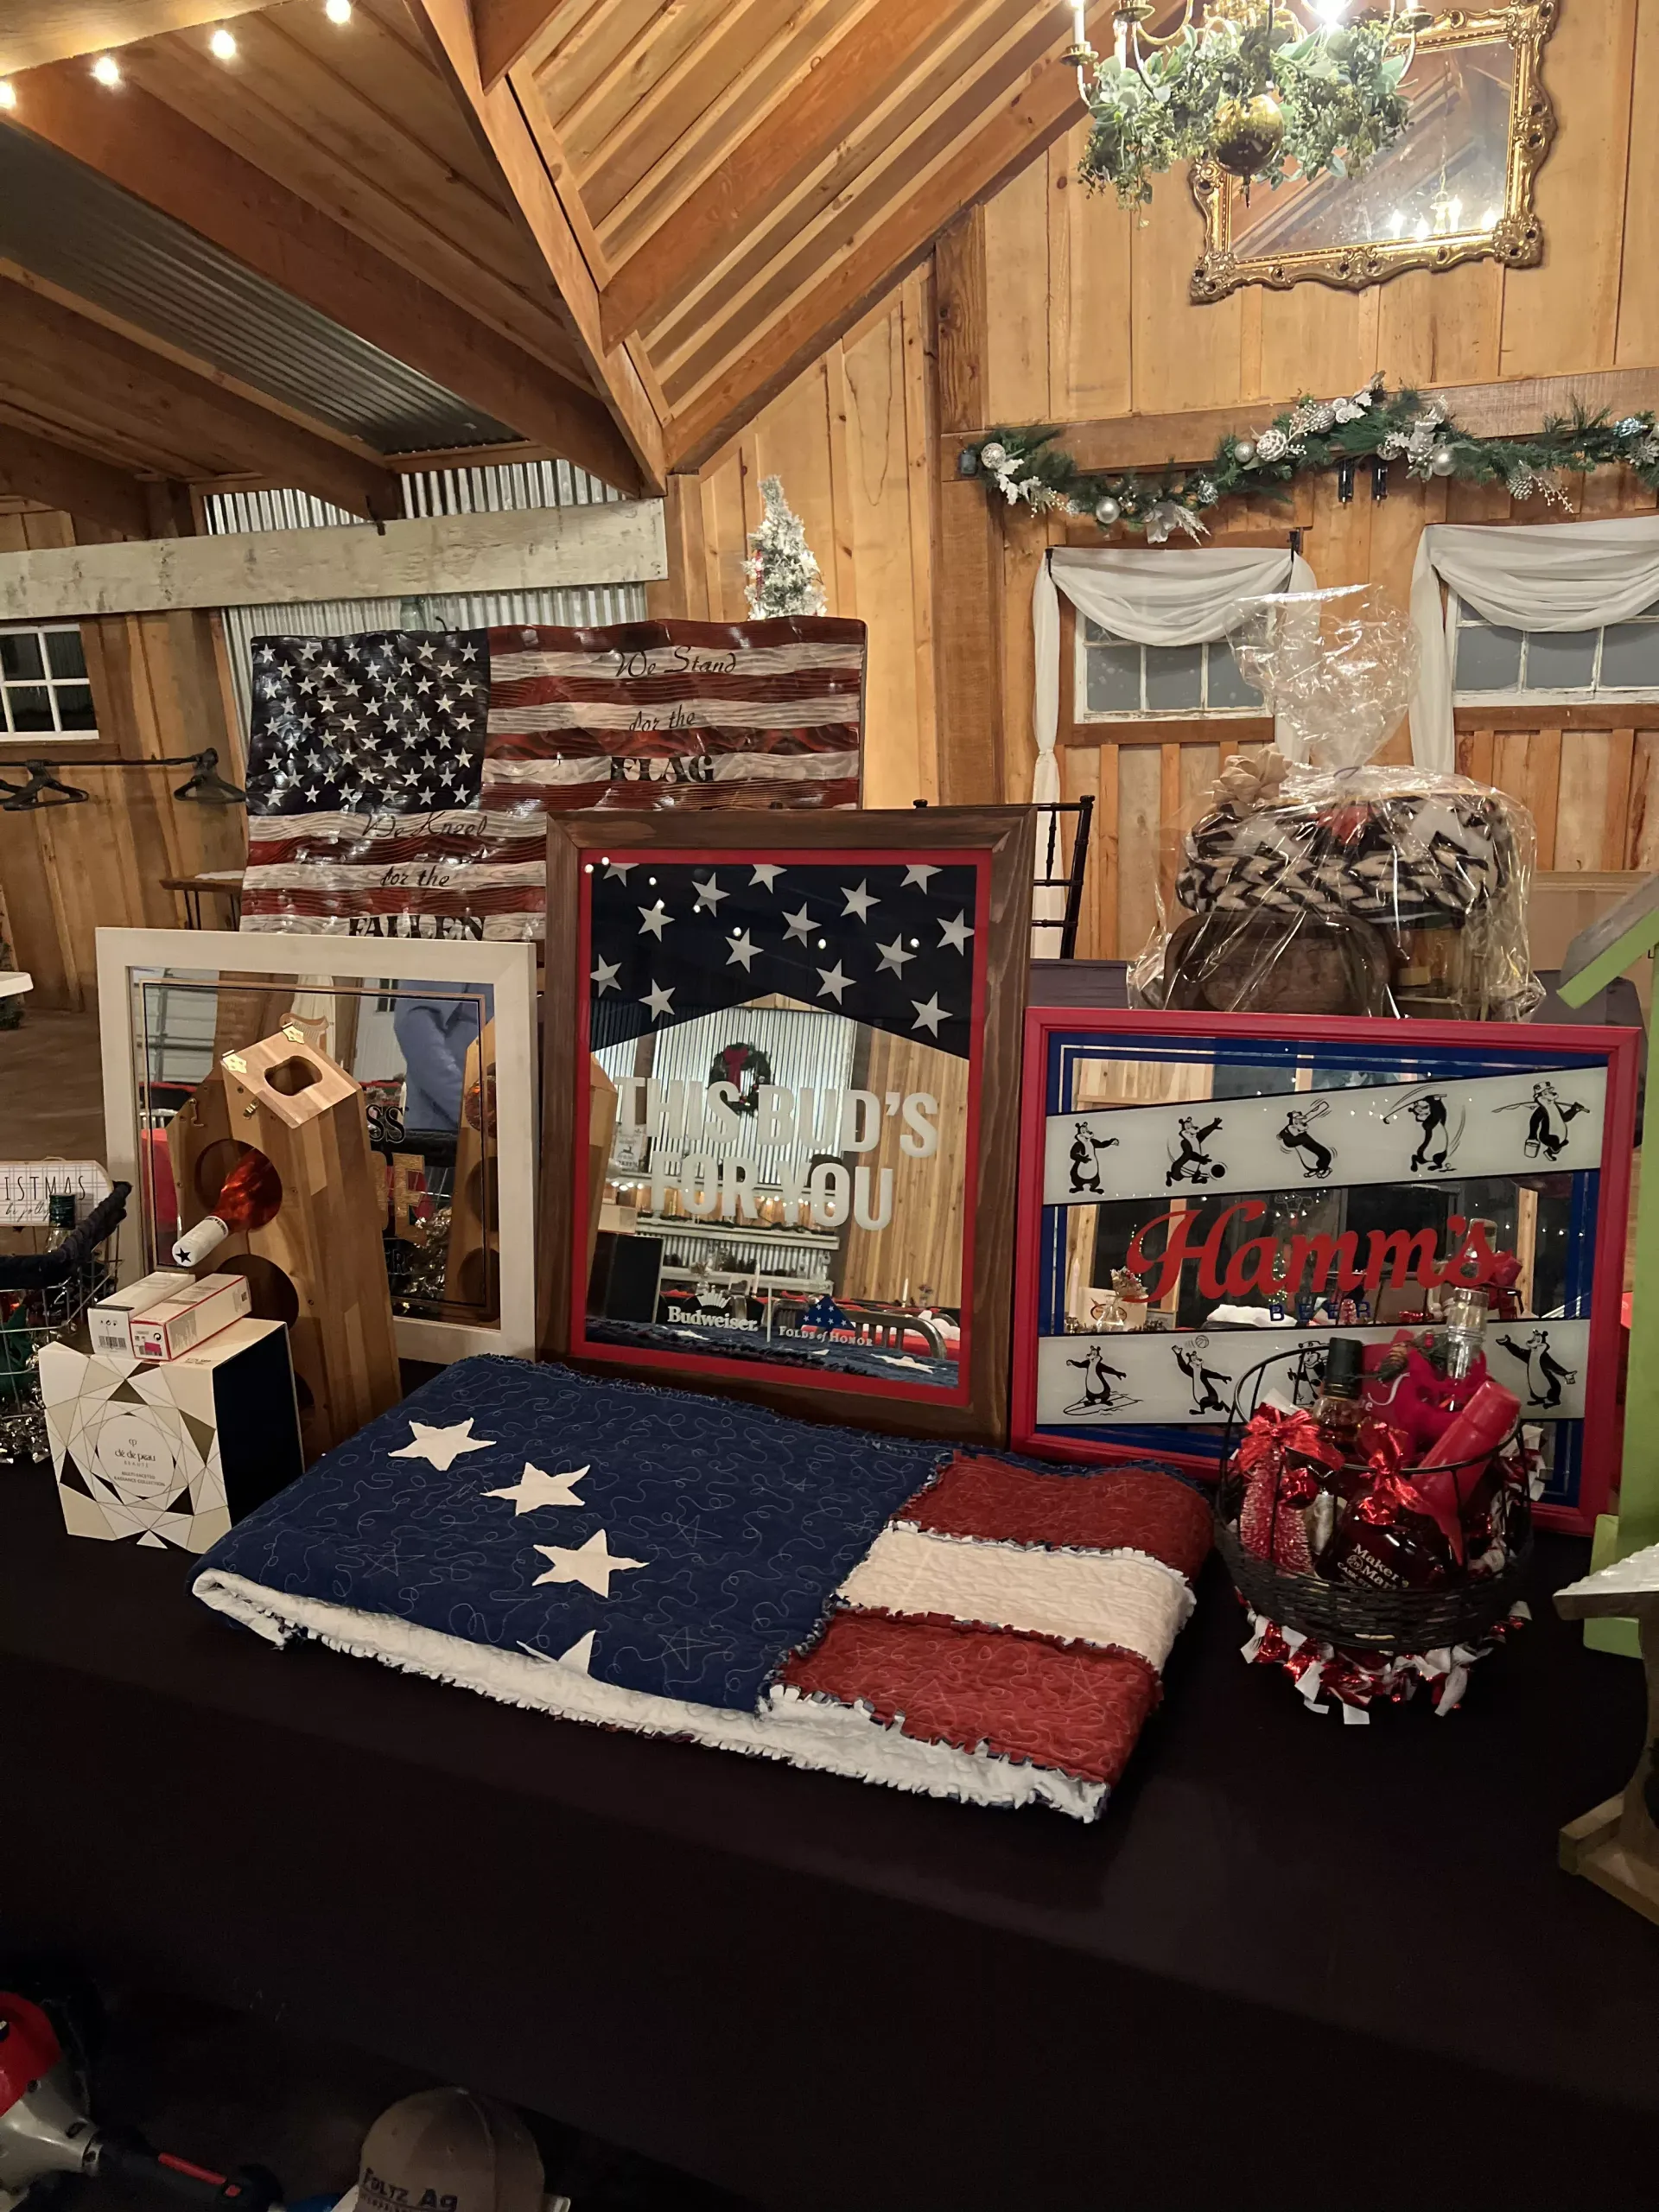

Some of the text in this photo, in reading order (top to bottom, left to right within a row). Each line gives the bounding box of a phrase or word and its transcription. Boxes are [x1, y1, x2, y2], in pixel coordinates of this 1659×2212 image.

[614, 645, 737, 677] We Stand
[629, 704, 696, 733] for the
[611, 754, 714, 783] FLAG
[359, 811, 488, 838] We Kneel
[380, 865, 451, 887] for the
[349, 914, 486, 942] FALLEN
[613, 1076, 938, 1159] THIS BUD'S
[651, 1150, 893, 1231] FOR YOU
[1120, 1200, 1513, 1304] Hamm's
[1269, 1301, 1371, 1322] BEER
[816, 1330, 828, 1343] of
